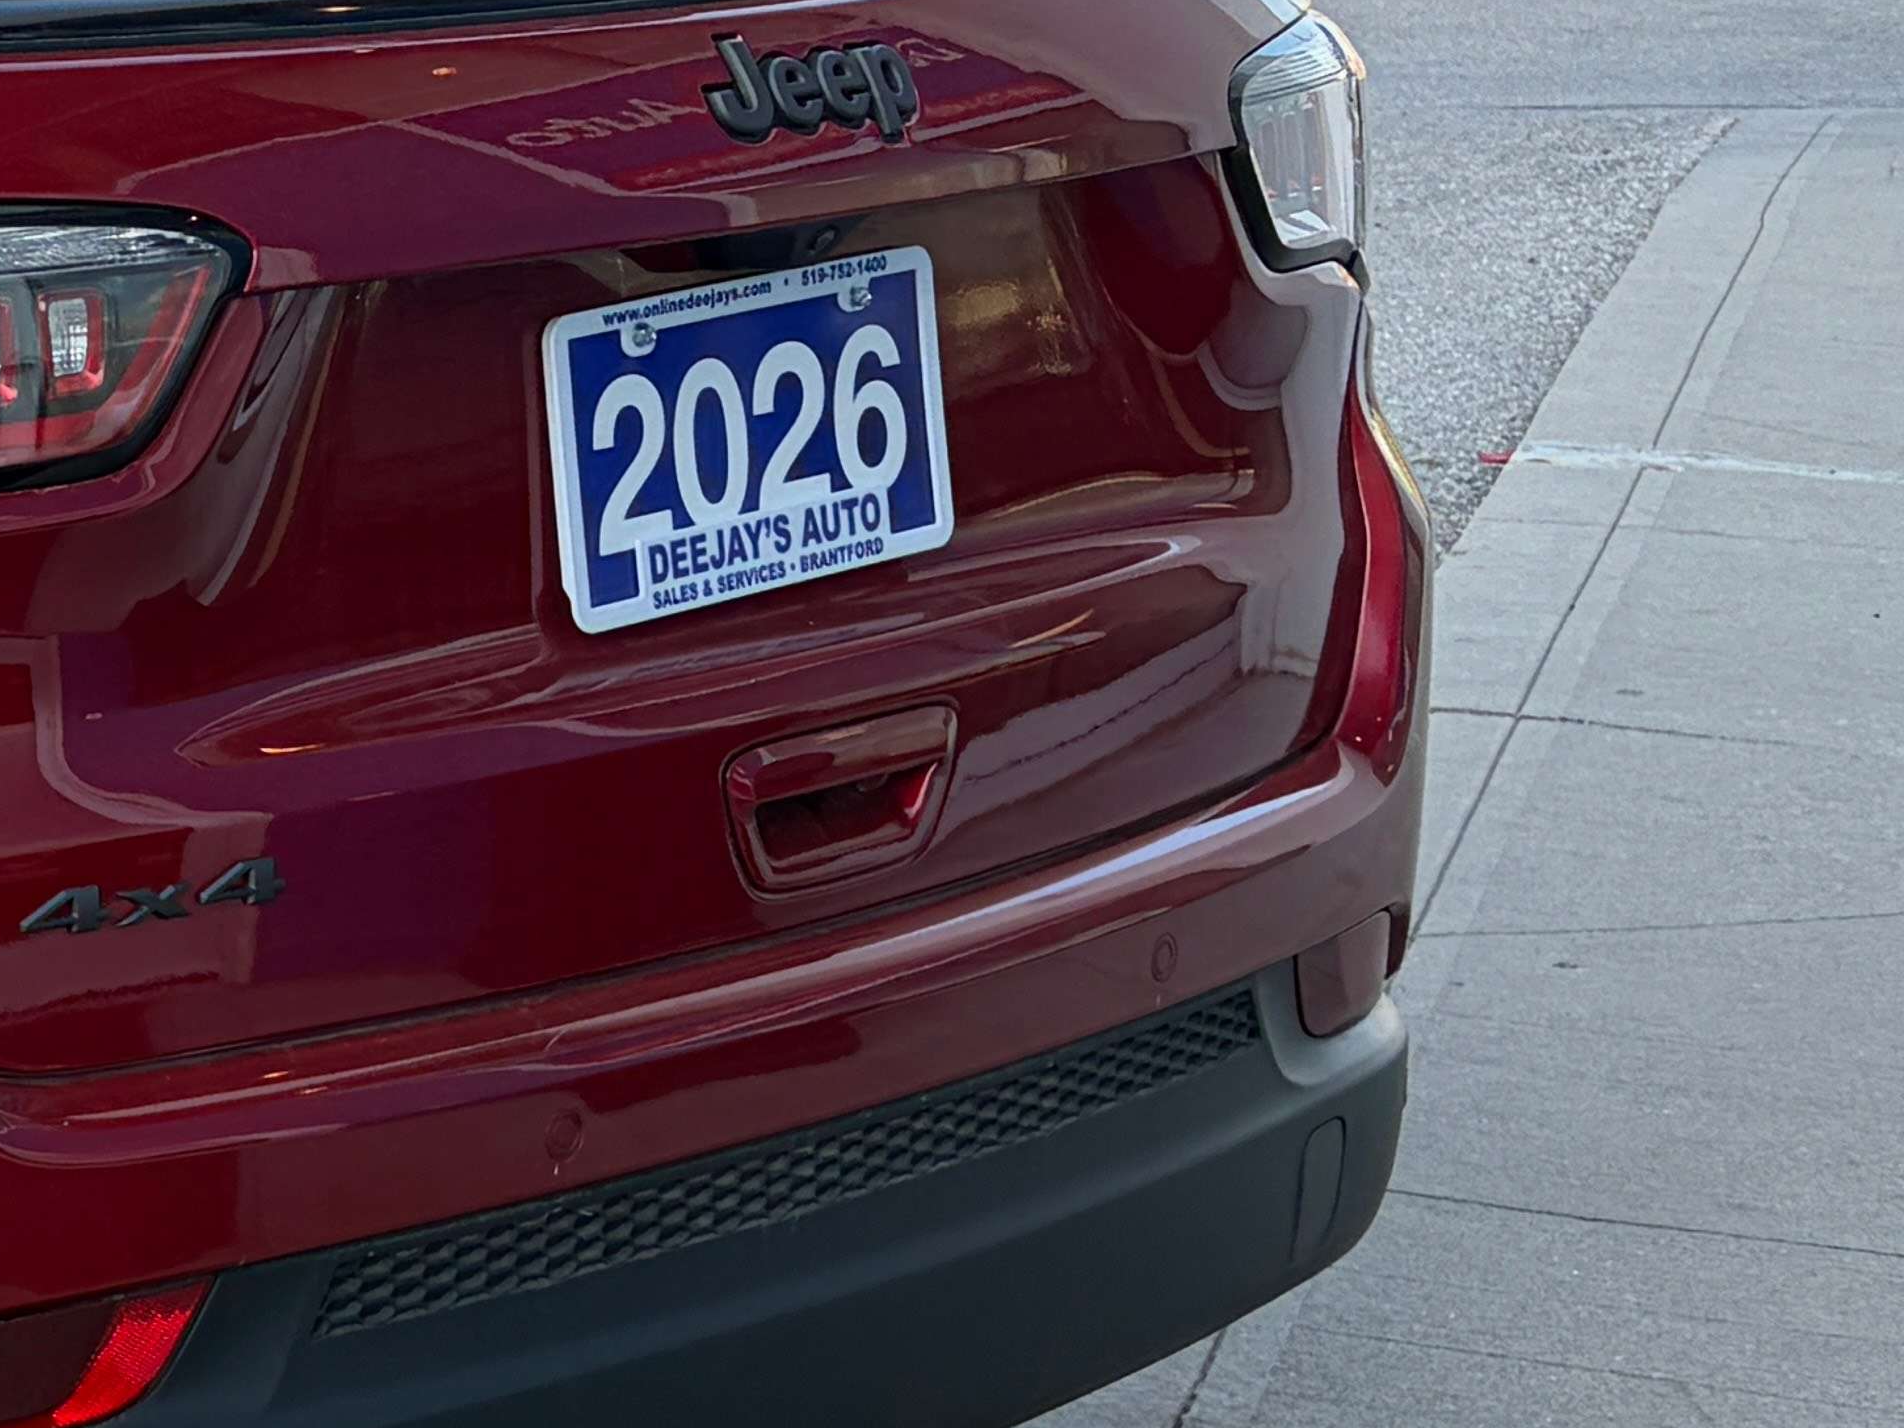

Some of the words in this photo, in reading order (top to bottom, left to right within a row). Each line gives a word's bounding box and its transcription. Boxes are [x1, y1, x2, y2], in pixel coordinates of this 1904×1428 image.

[700, 33, 920, 145] Jeep
[602, 281, 772, 327] www.onlinedeejays.com
[592, 324, 908, 557] 2026
[648, 514, 792, 585] DEEJAY'S
[802, 492, 882, 548] AUTO
[653, 582, 699, 610] SALES
[703, 578, 714, 598] &
[718, 560, 787, 594] SERVICES
[800, 536, 884, 573] BRANTFORD
[19, 857, 286, 933] 4x4
